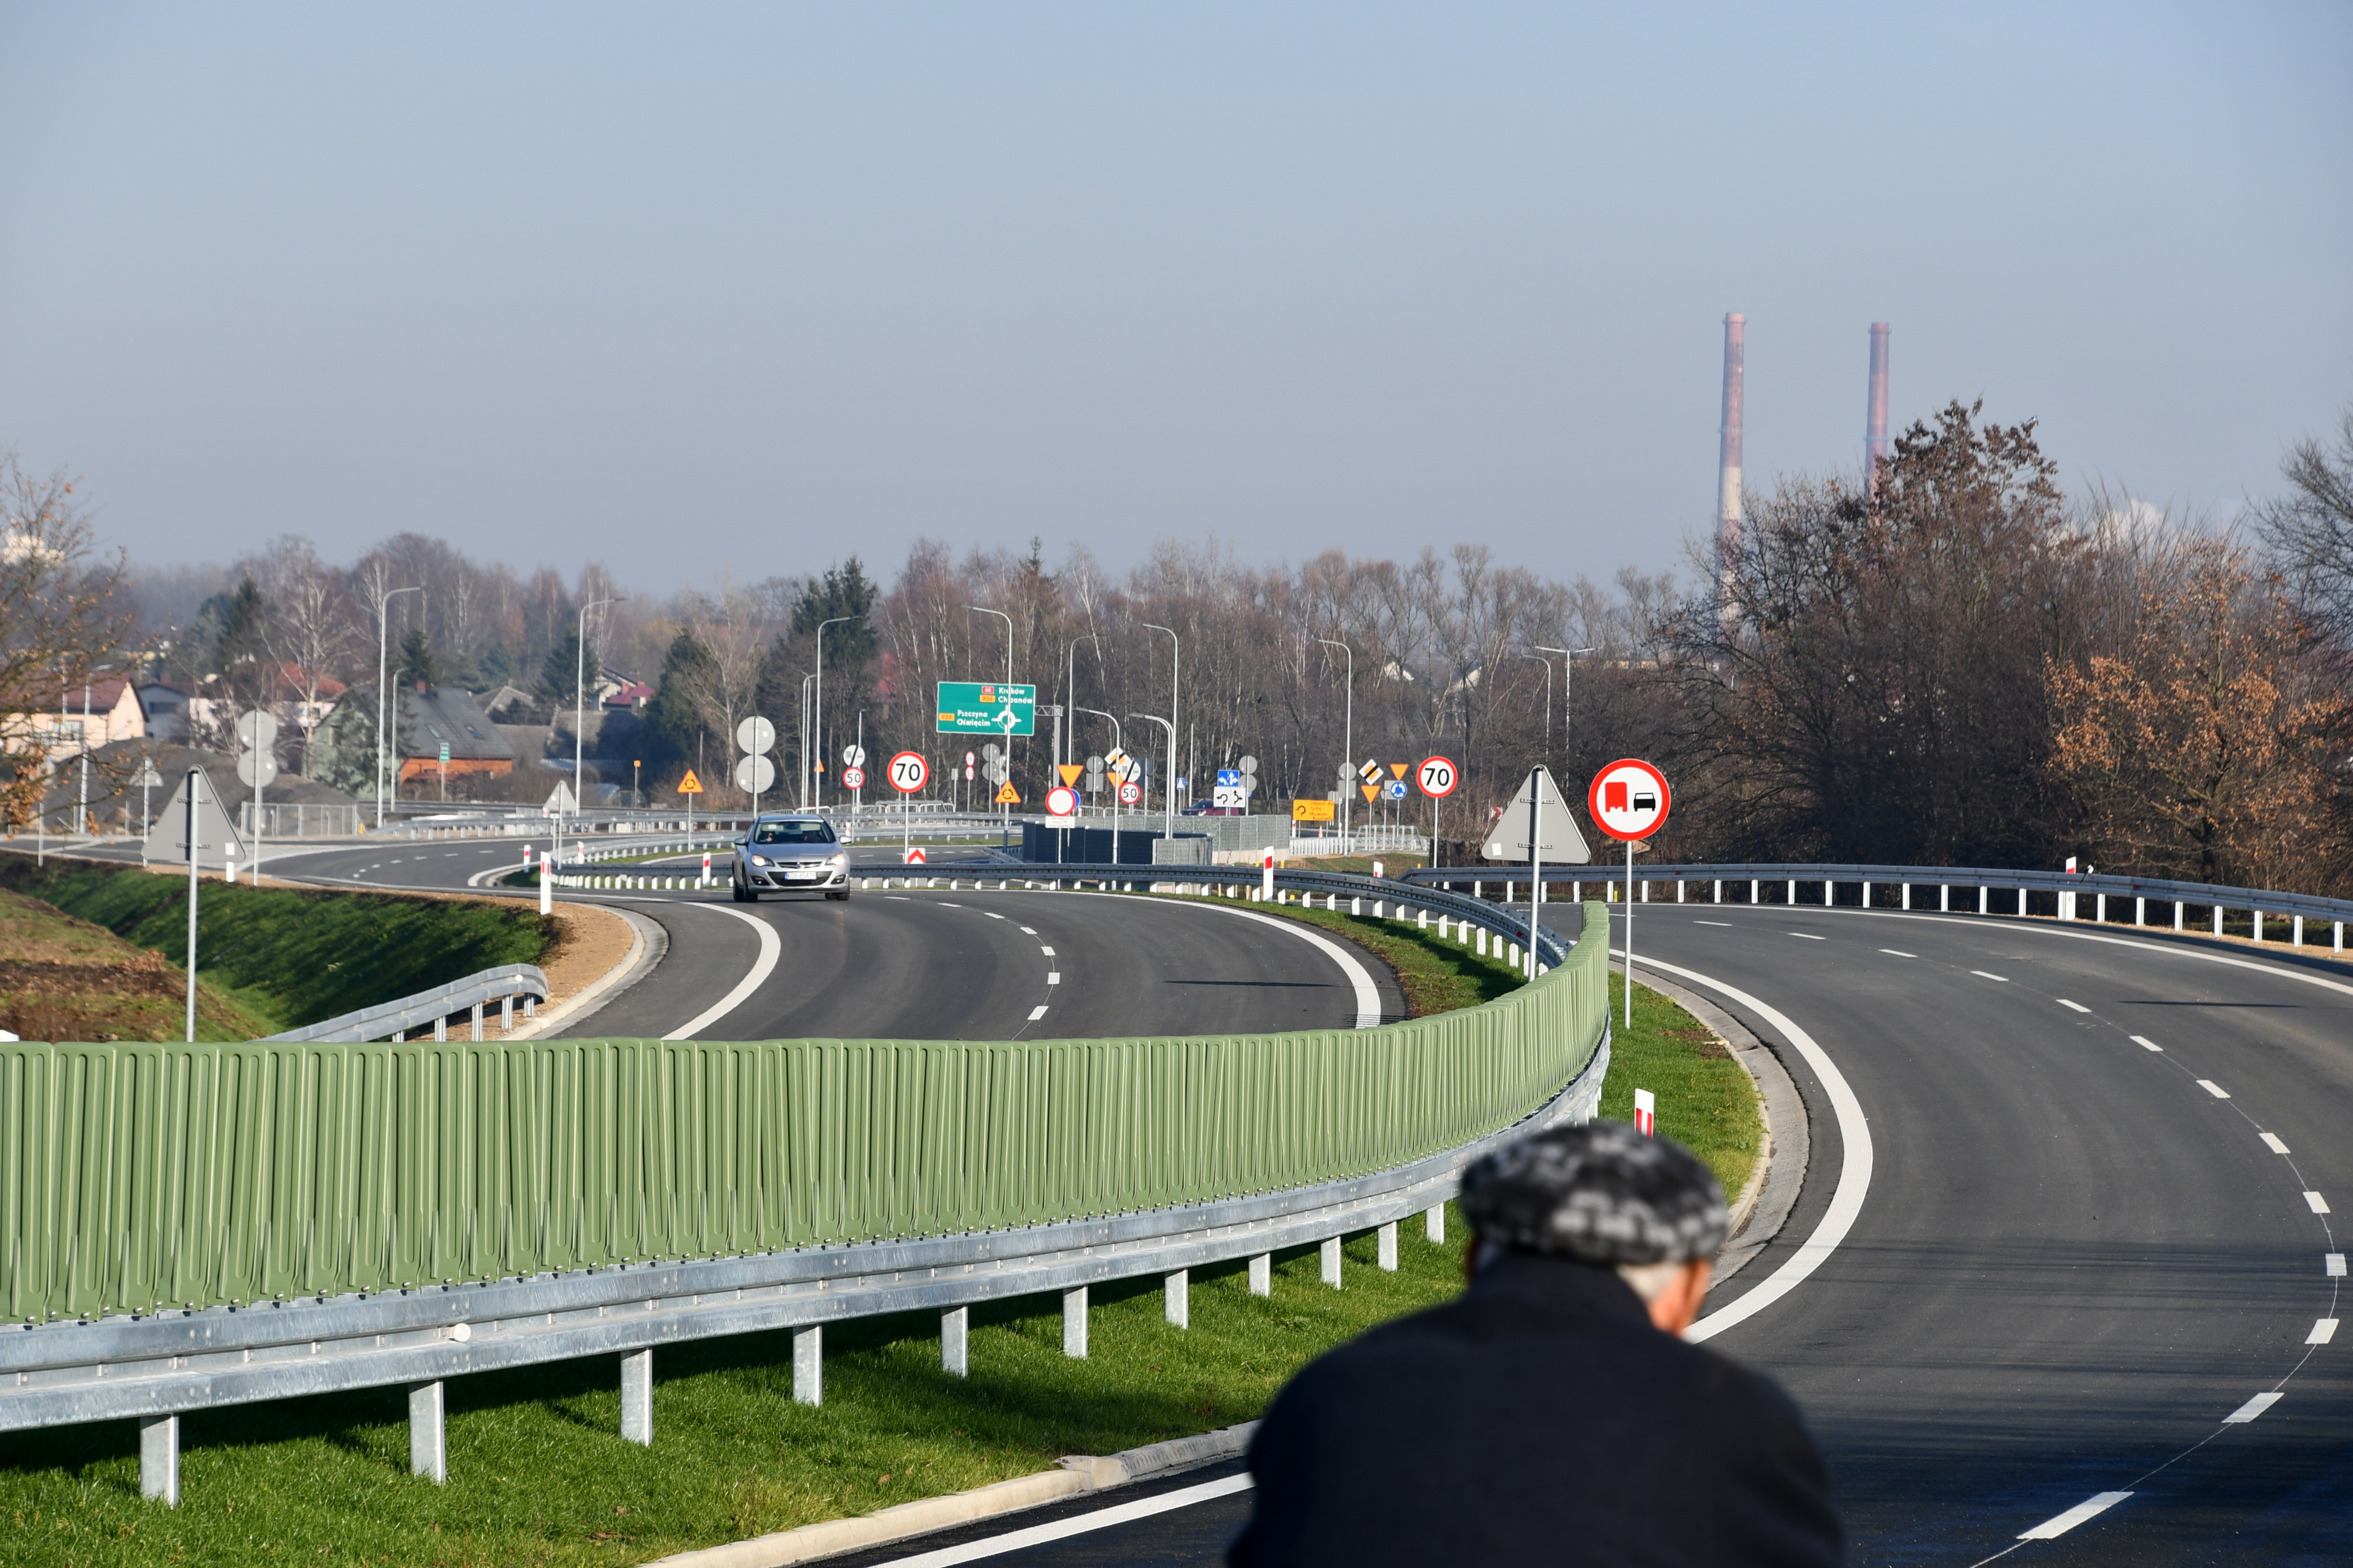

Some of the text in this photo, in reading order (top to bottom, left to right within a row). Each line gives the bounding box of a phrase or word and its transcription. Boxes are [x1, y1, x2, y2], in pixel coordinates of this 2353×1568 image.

[998, 696, 1032, 704] Chzanów
[957, 709, 988, 719] Pszczyna
[957, 718, 991, 728] Oświęcim
[896, 763, 920, 781] 70
[1425, 767, 1450, 787] 70
[847, 773, 861, 783] 50
[1123, 788, 1137, 798] 50
